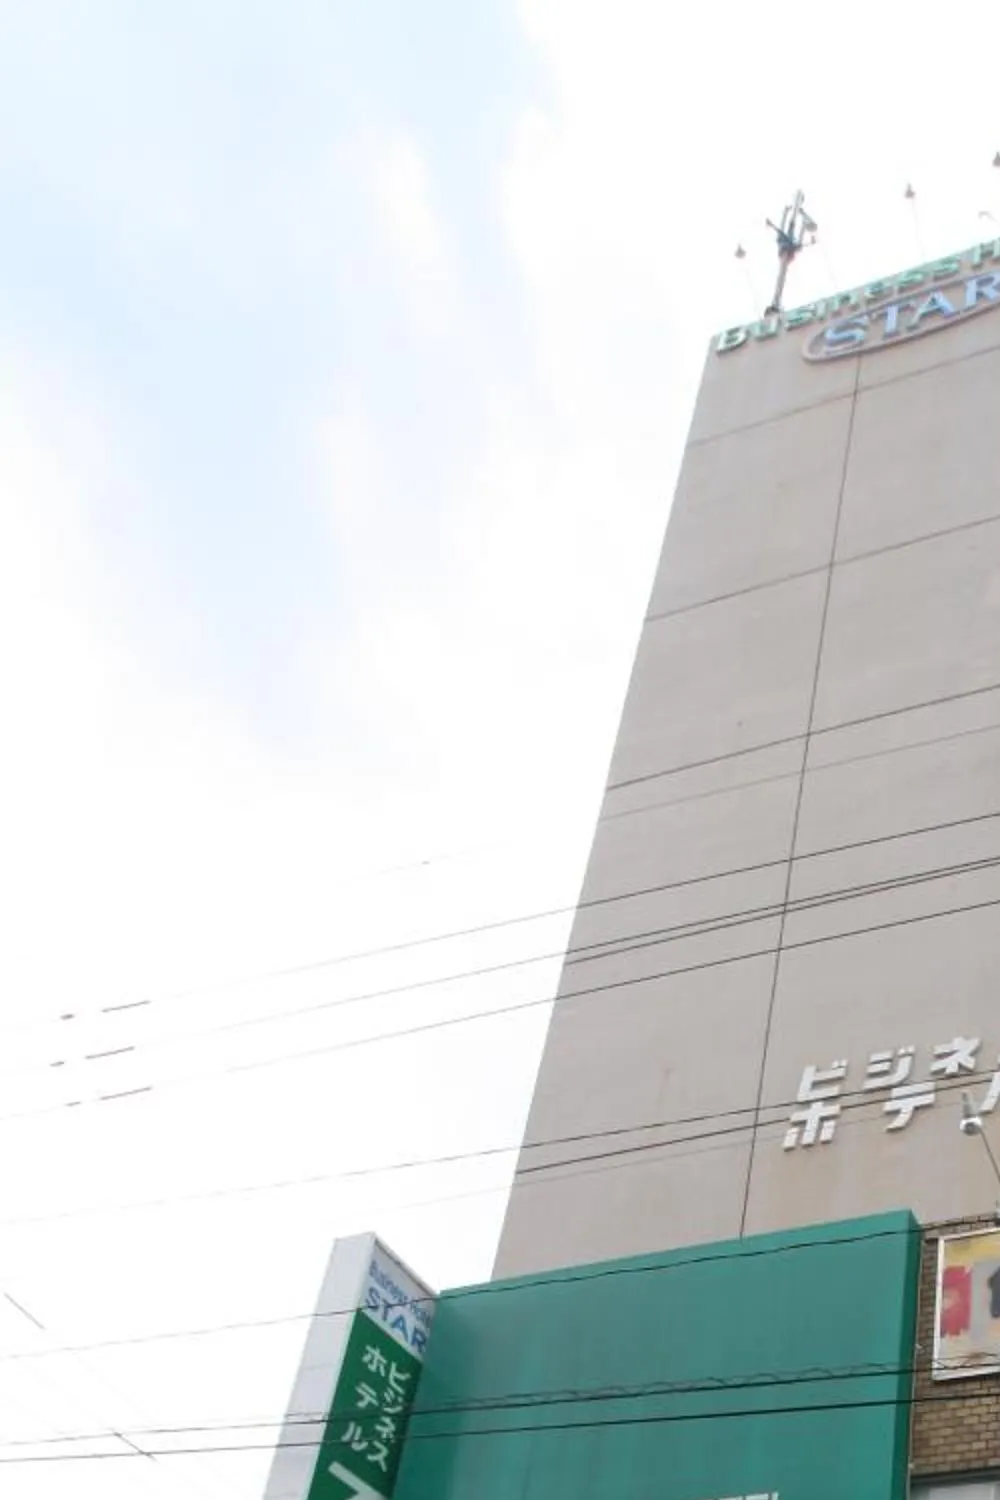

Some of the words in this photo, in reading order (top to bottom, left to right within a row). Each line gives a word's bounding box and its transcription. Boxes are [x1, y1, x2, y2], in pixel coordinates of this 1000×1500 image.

[715, 256, 958, 355] Business
[365, 1286, 426, 1352] STAR
[341, 1345, 387, 1451] ホテル
[367, 1361, 411, 1472] ビジネス
